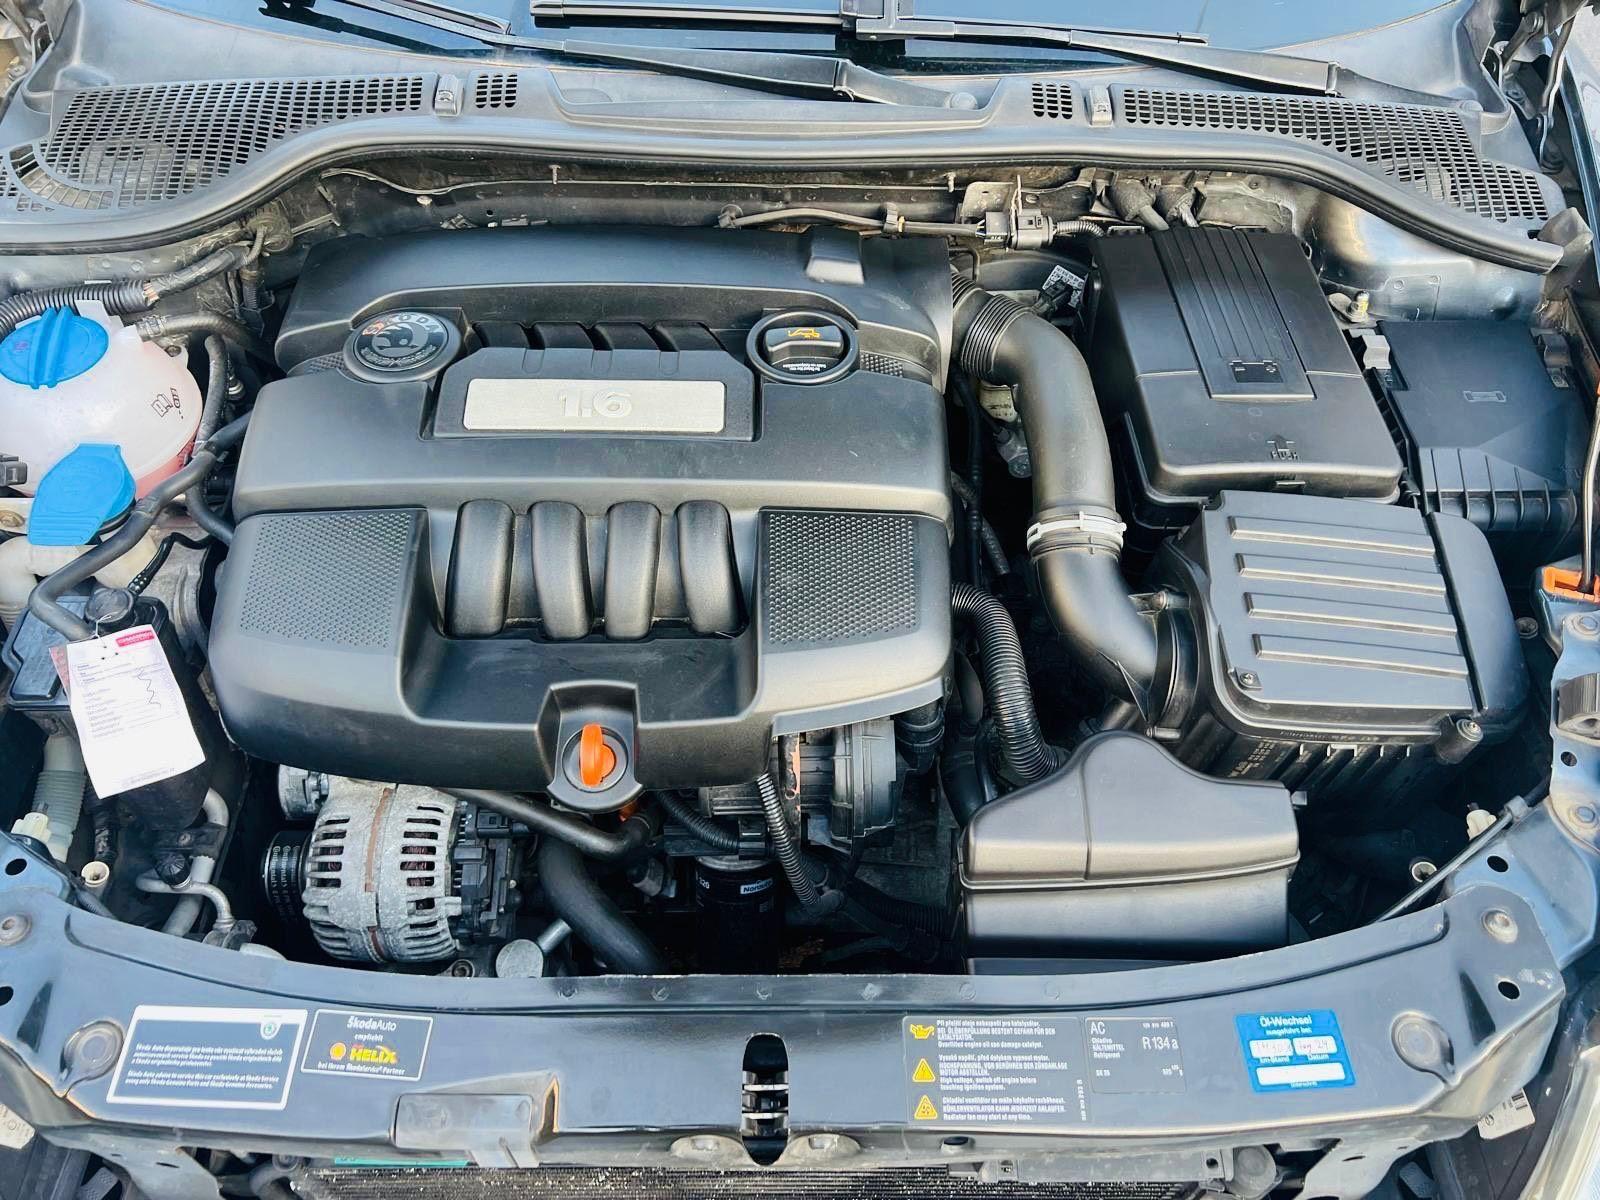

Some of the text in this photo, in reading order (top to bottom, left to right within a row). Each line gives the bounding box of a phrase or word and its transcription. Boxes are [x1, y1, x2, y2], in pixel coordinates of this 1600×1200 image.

[1090, 1021, 1106, 1035] AC
[1260, 1015, 1312, 1028] Öl-Wechsel
[1142, 1036, 1179, 1050] R 134 a
[350, 1045, 398, 1064] HELIX
